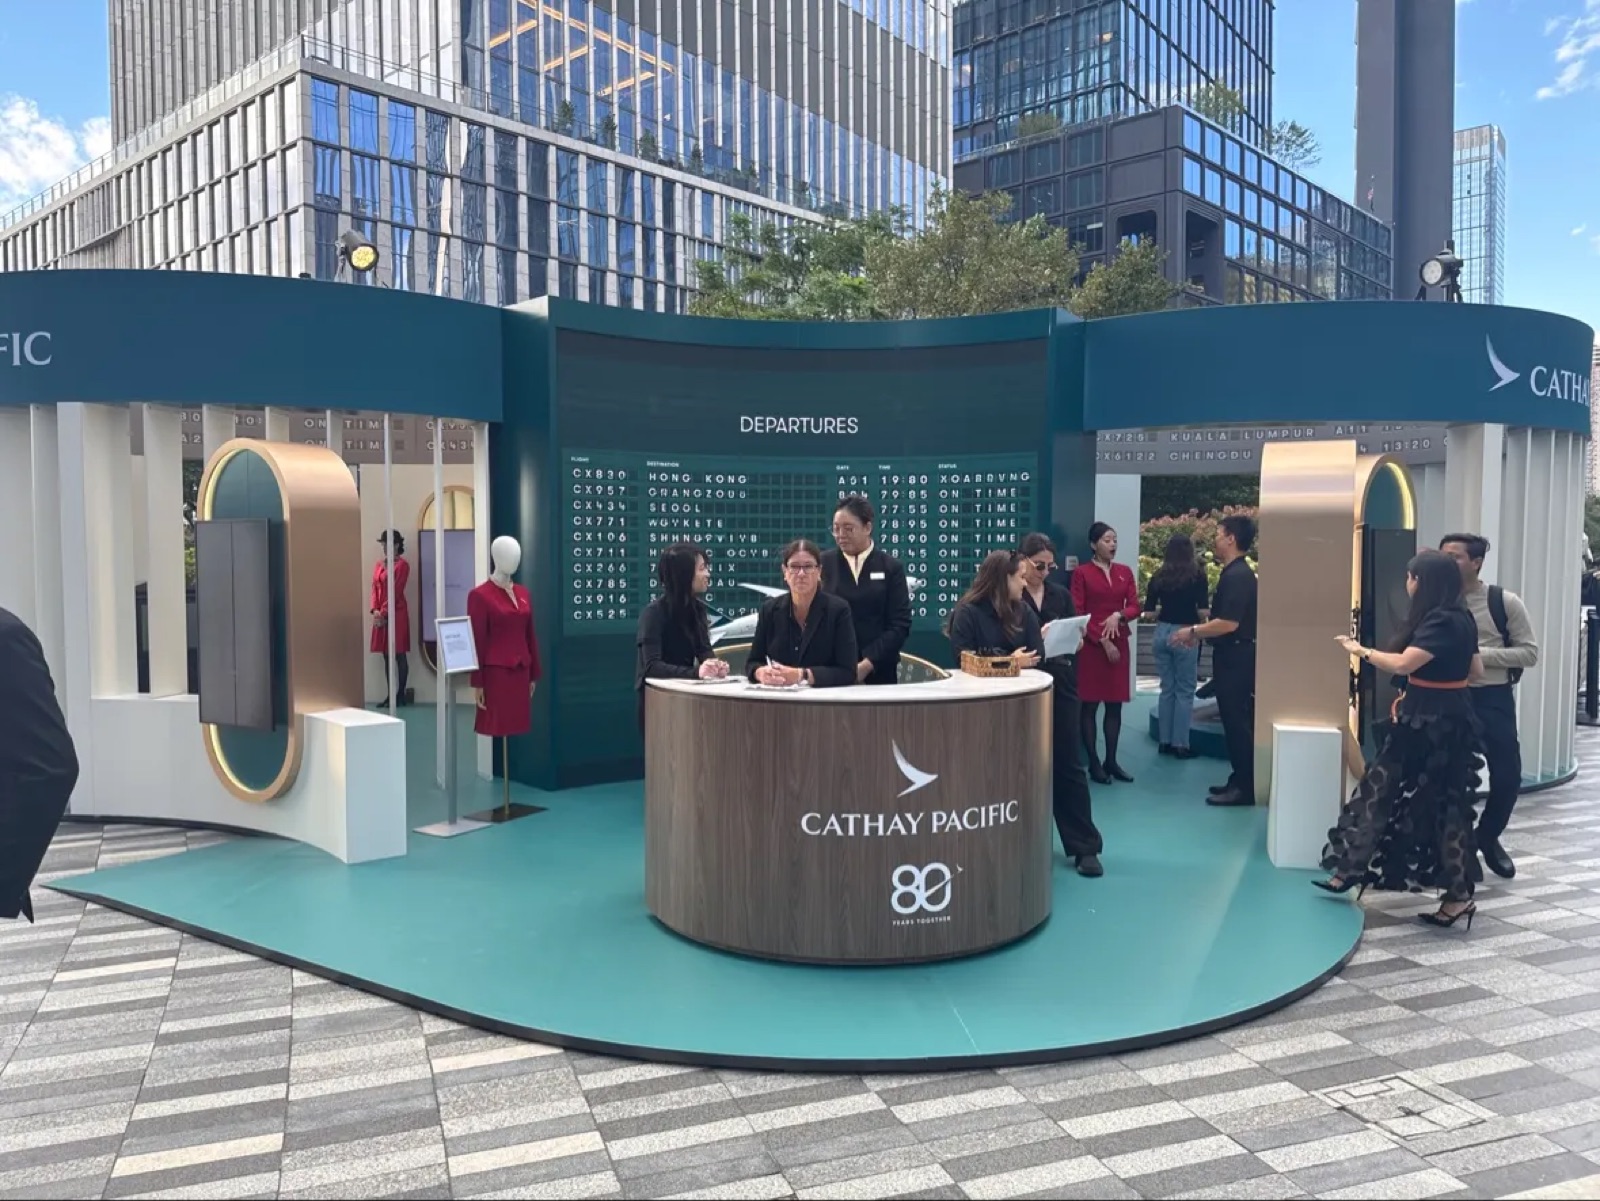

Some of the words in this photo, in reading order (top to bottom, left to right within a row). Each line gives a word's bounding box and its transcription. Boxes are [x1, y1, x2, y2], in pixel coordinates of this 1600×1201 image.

[1530, 366, 1590, 407] CATHA
[344, 420, 380, 430] TIM
[740, 416, 859, 434] DEPARTURES
[1171, 432, 1228, 442] KUALA
[1244, 428, 1314, 439] LUMPUR
[345, 440, 380, 450] TIM
[1169, 450, 1251, 461] CHENGDU
[1383, 439, 1430, 451] 13:20
[573, 468, 626, 480] CX830
[649, 473, 692, 483] HONG
[705, 474, 747, 484] KONG
[573, 484, 626, 495] CX957
[939, 489, 959, 499] ON
[975, 488, 1016, 498] TIME
[573, 500, 626, 511] CX434
[939, 504, 959, 514] ON
[975, 503, 1016, 513] TIME
[573, 516, 626, 526] CX771
[939, 519, 959, 529] ON
[975, 518, 1016, 528] TIME
[573, 532, 626, 542] CX106
[939, 534, 958, 543] ON
[975, 533, 1016, 543] TIME
[573, 547, 626, 557] CX711
[939, 549, 958, 558] ON
[573, 563, 626, 573] CX266
[939, 563, 958, 573] ON
[573, 578, 626, 589] CX785
[939, 578, 958, 587] ON
[573, 594, 626, 604] CX916
[939, 593, 958, 602] ON
[573, 609, 626, 620] CX525
[801, 812, 925, 836] CATHAY
[931, 800, 1019, 834] PACIFIC
[891, 862, 952, 914] 80
[916, 915, 951, 924] TOGETHER
